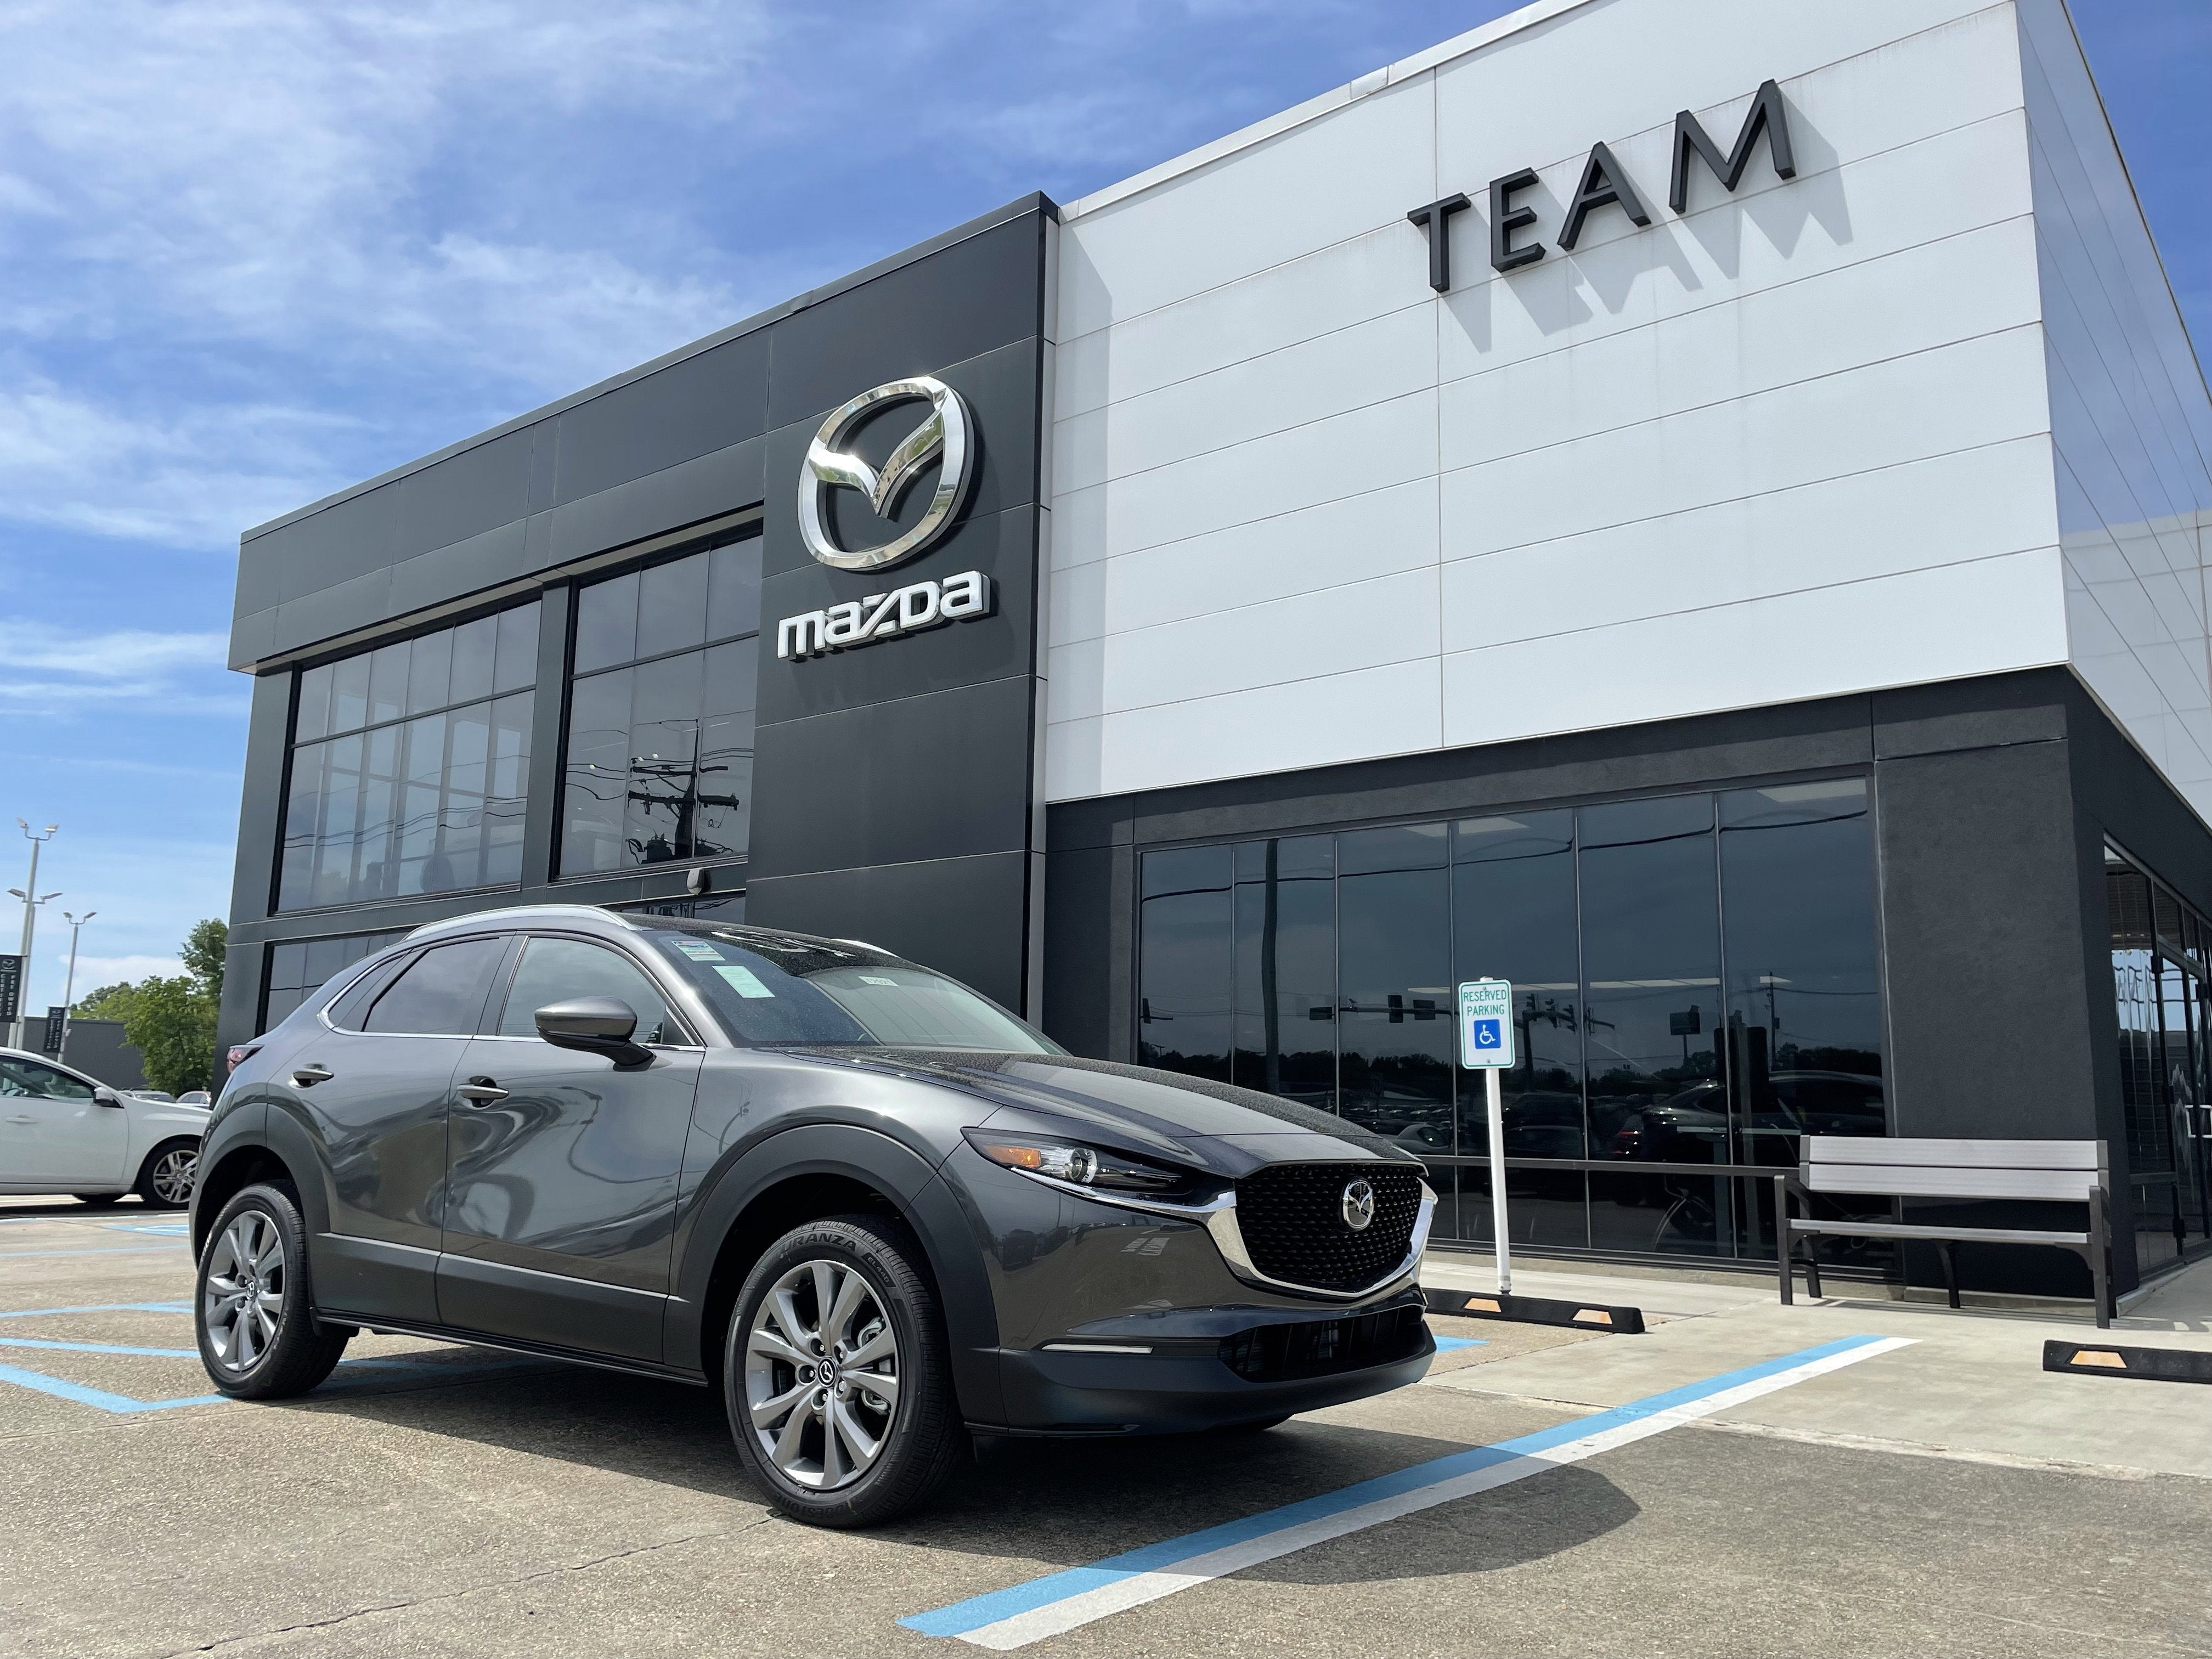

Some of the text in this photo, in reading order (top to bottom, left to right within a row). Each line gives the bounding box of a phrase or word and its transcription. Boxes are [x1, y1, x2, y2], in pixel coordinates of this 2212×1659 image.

[1407, 78, 1797, 293] TEAM
[1463, 990, 1506, 1002] RESERVED
[1467, 1003, 1505, 1016] PARKING
[777, 1232, 856, 1252] URANZA
[867, 1256, 890, 1283] EL440
